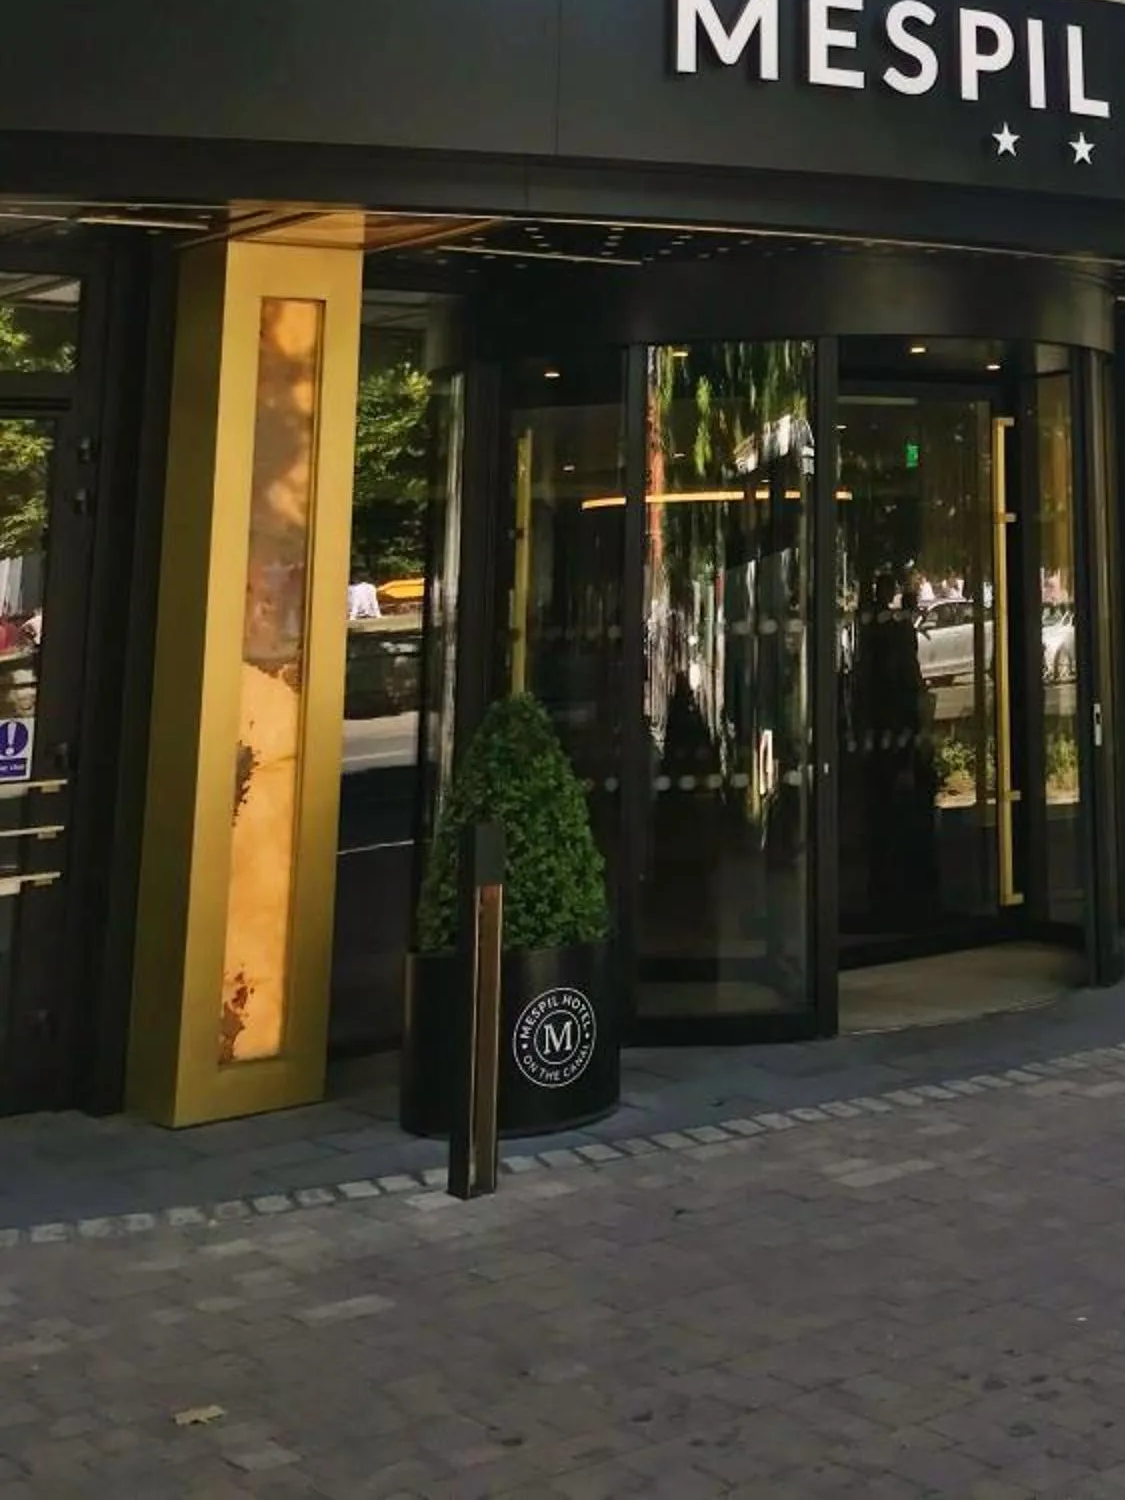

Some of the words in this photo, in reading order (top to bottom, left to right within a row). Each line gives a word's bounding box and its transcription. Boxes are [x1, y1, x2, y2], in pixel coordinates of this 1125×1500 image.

[519, 995, 559, 1039] MESPIL
[562, 993, 591, 1031] HOTEL
[543, 1020, 574, 1055] M
[523, 1055, 539, 1073] ON
[539, 1067, 561, 1081] THE
[563, 1044, 591, 1078] CANAL
